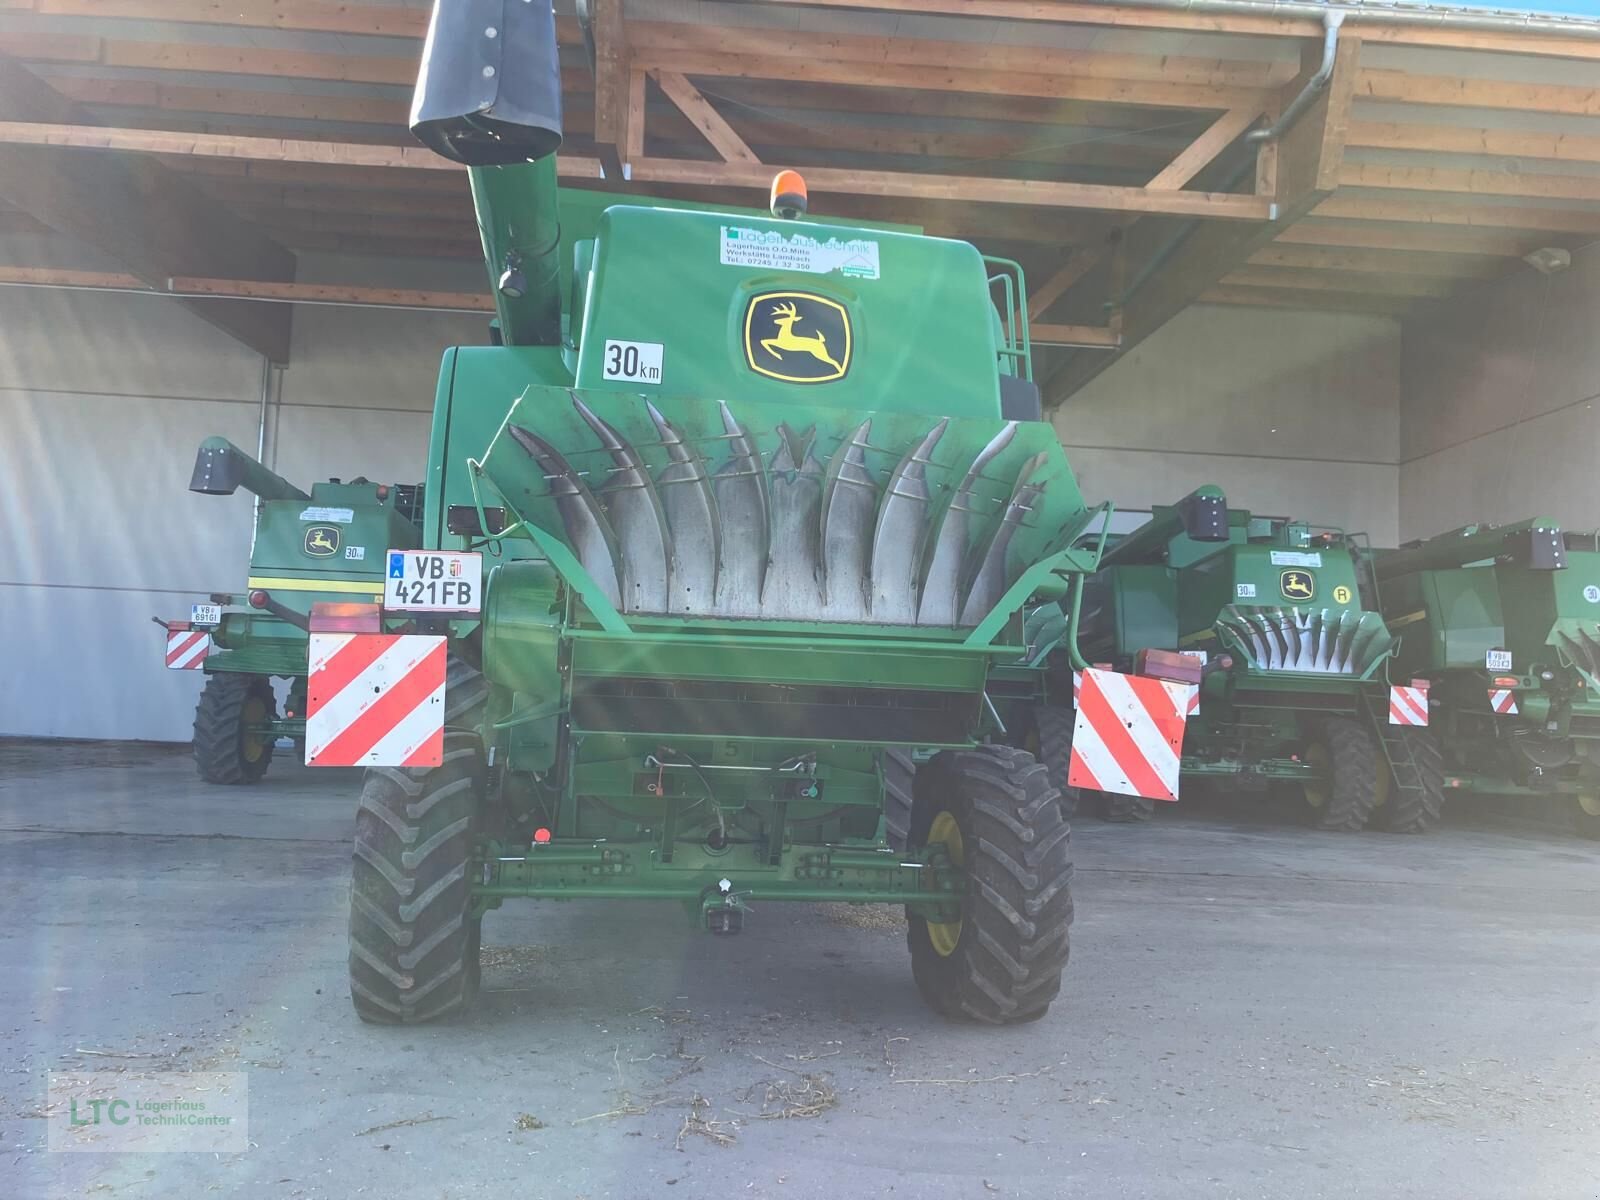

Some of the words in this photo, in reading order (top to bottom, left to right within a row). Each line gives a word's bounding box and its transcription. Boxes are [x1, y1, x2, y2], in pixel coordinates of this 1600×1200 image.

[726, 241, 770, 251] Lagerhaus
[747, 258, 772, 266] 07245
[772, 253, 810, 262] Lambach
[415, 556, 444, 579] VB
[395, 580, 472, 605] 421FB
[1337, 588, 1347, 600] R
[200, 606, 210, 614] VB
